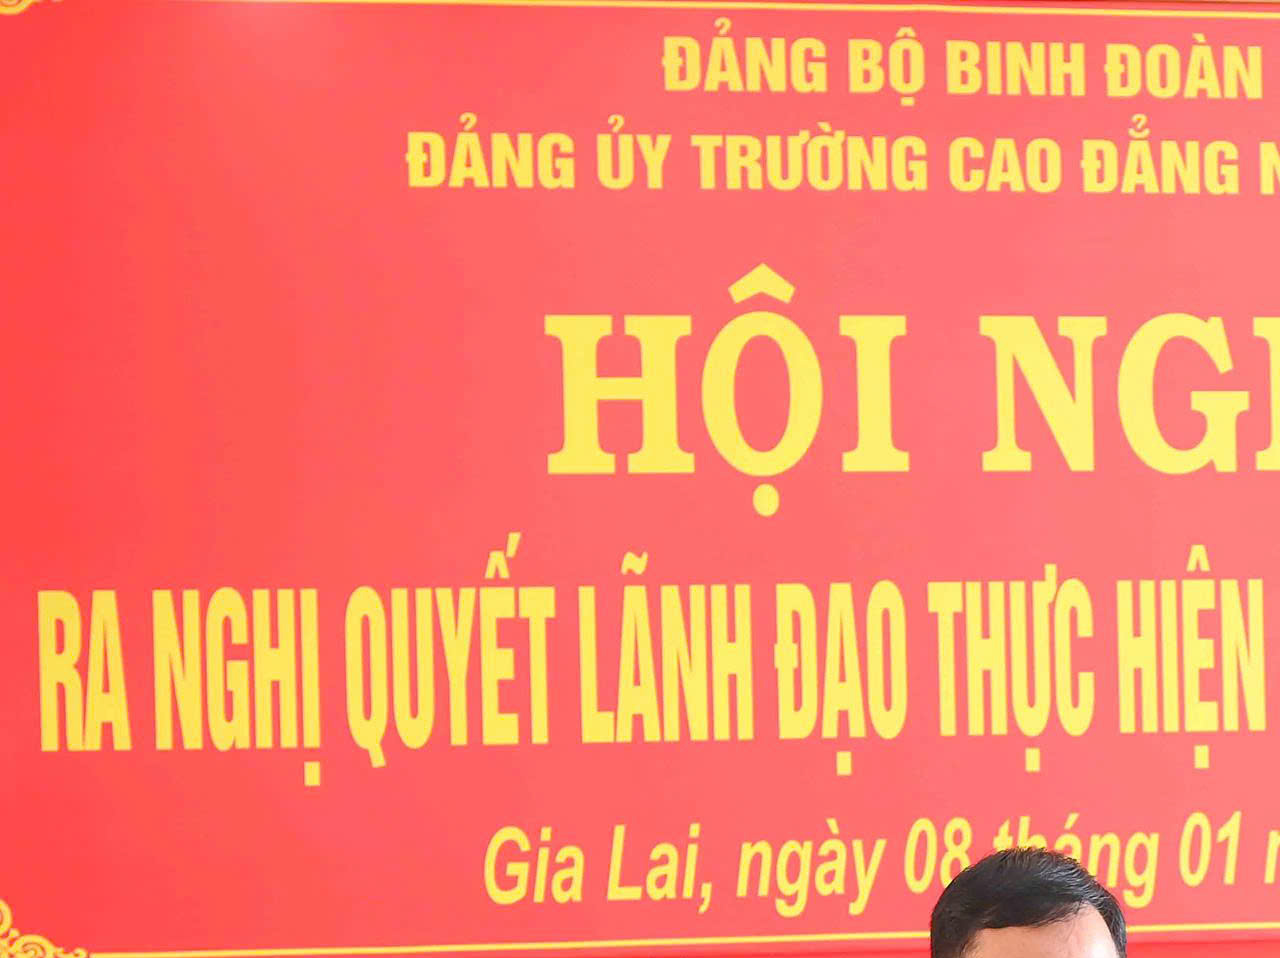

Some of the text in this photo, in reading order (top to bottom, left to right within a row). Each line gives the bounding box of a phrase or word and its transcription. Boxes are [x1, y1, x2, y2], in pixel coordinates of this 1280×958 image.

[662, 18, 827, 92] ĐẢNG
[848, 28, 924, 106] BỘ
[947, 40, 1085, 96] BINH
[1105, 33, 1262, 99] ĐOÀN
[406, 113, 574, 188] ĐẢNG
[598, 115, 671, 189] ỦY
[691, 122, 927, 191] TRƯỜNG
[949, 137, 1061, 192] CAO
[1080, 114, 1239, 195] ĐẲNG
[545, 264, 909, 516] HỘI
[39, 591, 131, 751] RA
[154, 588, 320, 786] NGHỊ
[346, 533, 555, 767] QUYẾT
[579, 552, 753, 743] LÃNH
[774, 580, 907, 775] ĐẠO
[928, 564, 1094, 772] THỰC
[1117, 544, 1266, 768] HIỆN
[485, 827, 584, 904] Gia
[608, 824, 712, 912] Lai,
[737, 818, 886, 917] ngày
[904, 818, 972, 893] 08
[1179, 811, 1241, 886] 01
